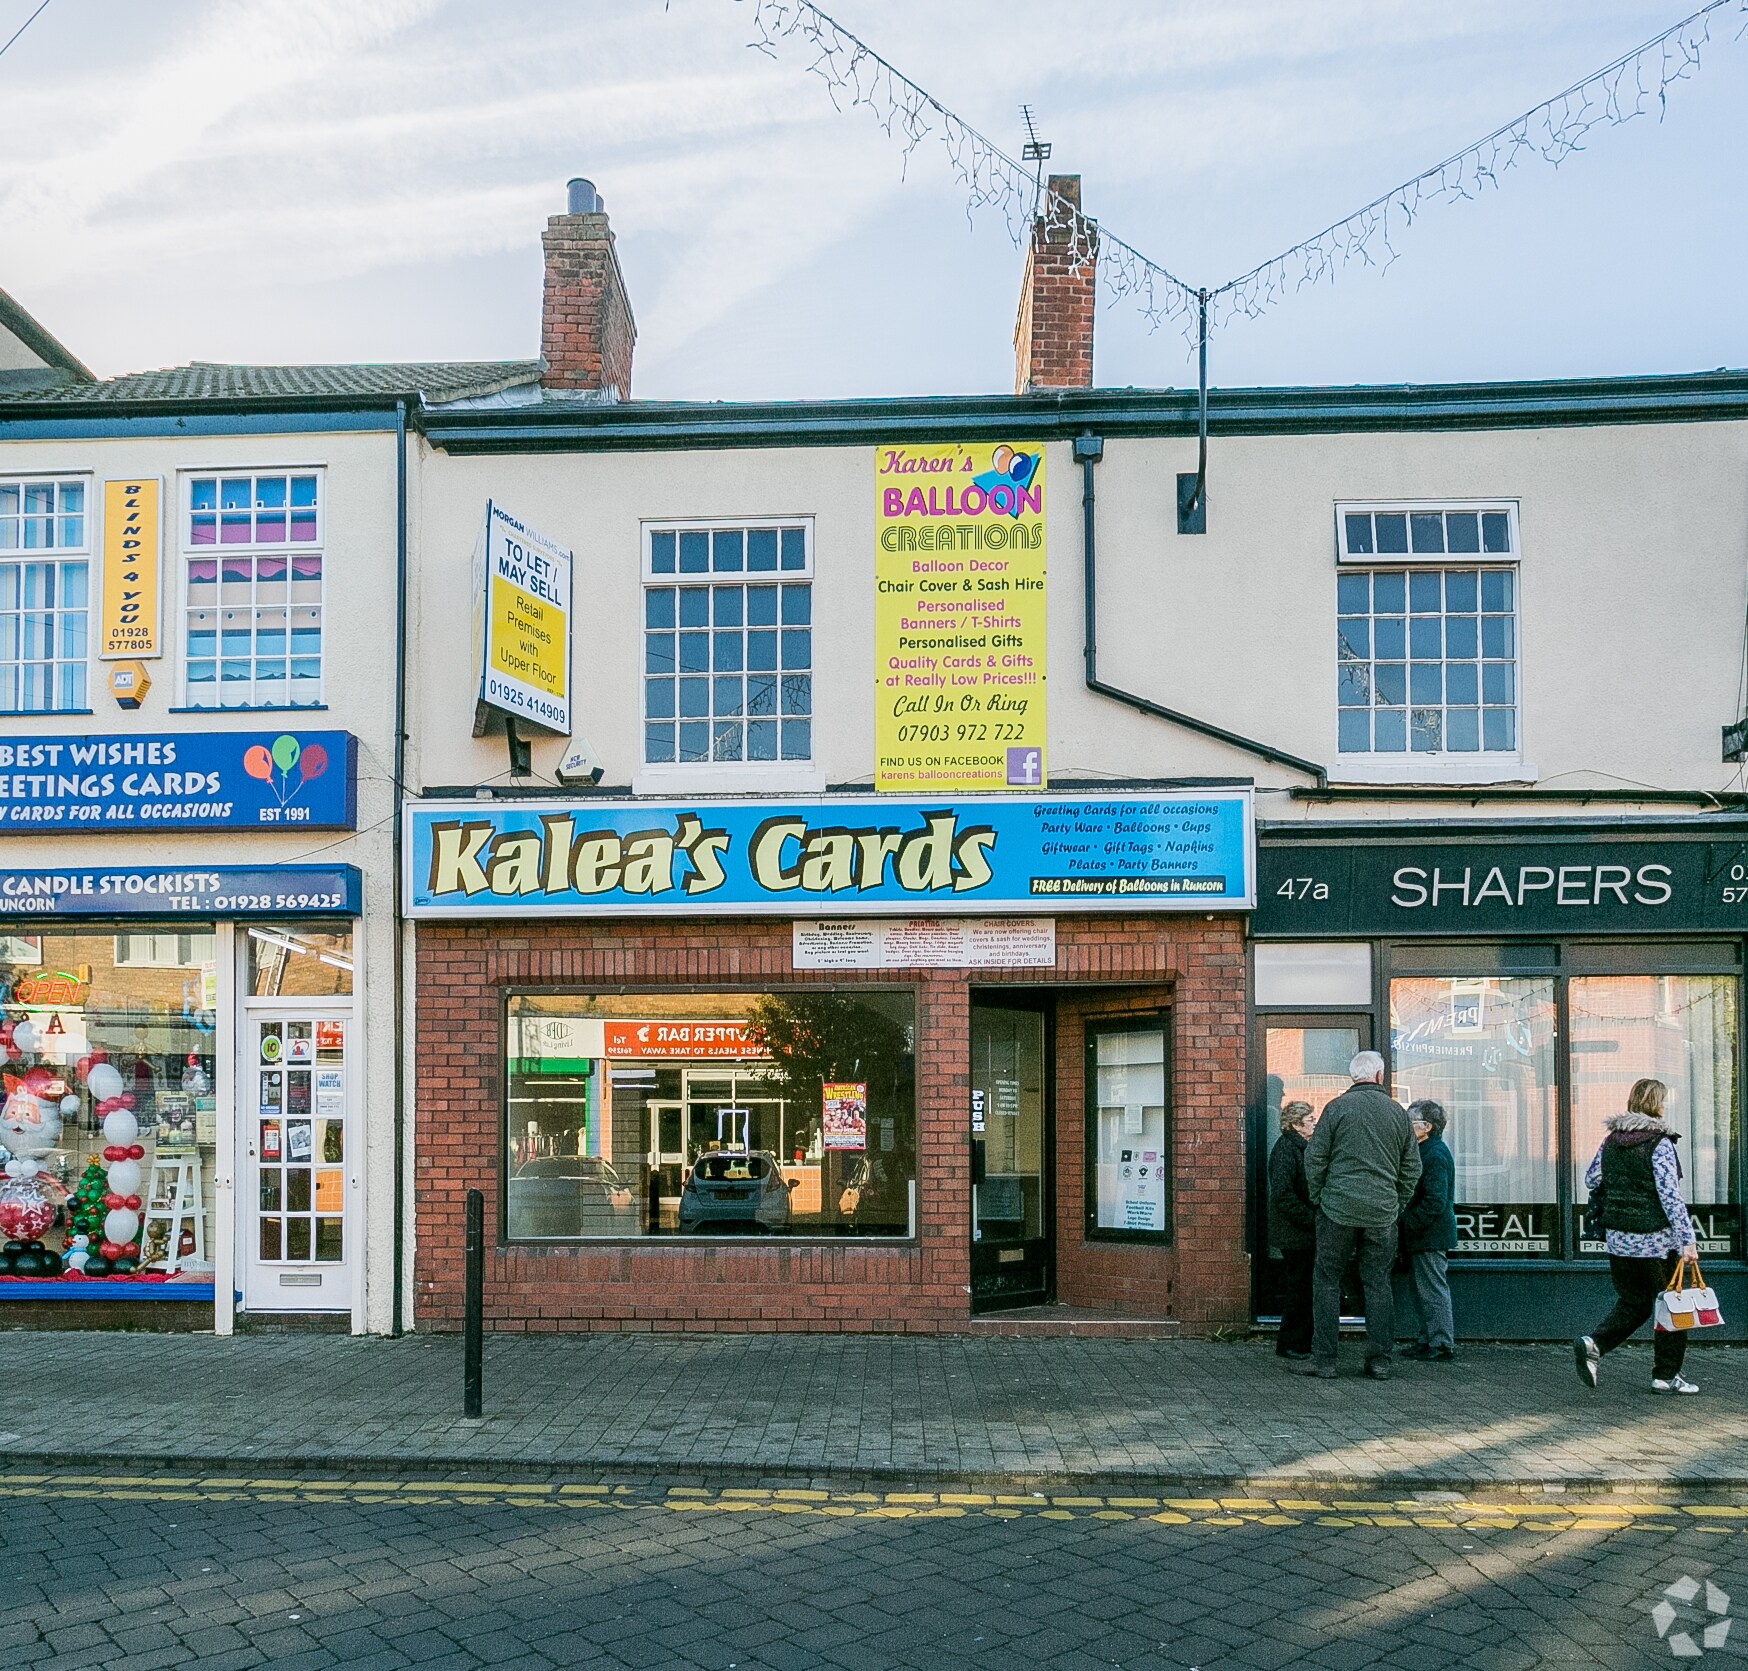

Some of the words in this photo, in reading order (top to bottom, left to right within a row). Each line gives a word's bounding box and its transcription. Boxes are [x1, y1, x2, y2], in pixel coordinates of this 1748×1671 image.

[880, 448, 973, 474] Karen's
[883, 484, 1042, 517] BALLOON
[493, 506, 524, 533] MORGAN
[880, 523, 1042, 552] CREATIONS
[505, 538, 522, 562] TO
[527, 552, 550, 579] LET
[912, 560, 964, 572] Balloon
[970, 560, 1009, 572] Decor
[499, 556, 526, 584] MAY
[530, 576, 562, 606] SELL
[878, 580, 914, 593] Chair
[920, 580, 957, 592] Cover
[963, 579, 972, 591] &
[978, 578, 1009, 592] Sash
[1016, 578, 1044, 590] Hire
[517, 596, 544, 622] Retail
[918, 600, 1004, 612] Personalised
[508, 611, 552, 644] Premises
[901, 617, 956, 630] Banners
[960, 616, 968, 629] /
[972, 616, 1022, 628] T-Shirts
[112, 628, 148, 638] 01928
[900, 636, 986, 648] Personalised
[992, 634, 1023, 647] Gifts
[108, 640, 152, 650] 577805
[520, 638, 538, 658] with
[500, 646, 530, 672] Upper
[532, 663, 556, 685] Floor
[889, 656, 937, 671] Quality
[943, 656, 981, 668] Cards
[986, 655, 996, 668] &
[1002, 654, 1033, 668] Gifts
[114, 674, 132, 685] ADT
[886, 675, 900, 686] at
[905, 674, 946, 688] Really
[952, 674, 977, 685] Low
[983, 672, 1036, 685] Prices!!!
[490, 680, 524, 707] 01925
[527, 696, 565, 724] 414909
[894, 694, 930, 717] Call
[934, 694, 954, 713] In
[960, 694, 980, 712] Or
[987, 694, 1028, 716] Ring
[898, 724, 950, 742] 07903
[956, 724, 987, 741] 972
[994, 724, 1025, 740] 722
[0, 744, 63, 767] BEST
[69, 742, 176, 766] WISHES
[881, 757, 905, 767] FIND
[908, 757, 922, 766] US
[925, 757, 941, 766] ON
[944, 756, 1004, 766] FACEBOOK
[566, 758, 587, 770] SECURITY
[881, 770, 915, 780] karens
[918, 770, 1003, 779] ballooncreations
[122, 771, 220, 797] CARDS
[10, 806, 65, 821] CARDS
[69, 806, 100, 821] FOR
[106, 804, 134, 819] ALL
[140, 802, 233, 818] OCCASIONS
[259, 808, 281, 821] EST
[284, 807, 310, 821] 1991
[1034, 804, 1080, 818] Greeting
[1084, 804, 1117, 816] Cards
[1120, 804, 1137, 817] for
[1140, 803, 1160, 815] all
[1163, 803, 1218, 815] occasions
[1041, 822, 1071, 835] Party
[1074, 822, 1103, 833] Ware
[1114, 822, 1170, 833] Balloons
[1182, 821, 1211, 833] Cups
[428, 812, 732, 896] Kalea's
[749, 809, 999, 894] Cards
[1041, 842, 1091, 855] Giftwear
[1104, 841, 1126, 855] Gift
[1128, 841, 1154, 855] Tags
[1165, 840, 1214, 854] Napkins
[1069, 859, 1107, 870] Plates
[1118, 859, 1148, 872] Party
[1151, 859, 1198, 870] Banners
[1731, 864, 1748, 880] 0
[2, 876, 93, 896] CANDLE
[99, 873, 220, 894] STOCKISTS
[1032, 880, 1061, 892] FREE
[1062, 879, 1103, 895] Delivery
[1106, 879, 1117, 894] of
[1119, 879, 1169, 892] Balloons
[1170, 879, 1180, 892] in
[1182, 879, 1223, 891] Runcorn
[1276, 878, 1328, 901] 47a
[1390, 864, 1673, 908] SHAPERS
[0, 897, 55, 912] UNCORN
[214, 895, 271, 910] 01928
[275, 894, 341, 909] 569425
[17, 981, 81, 1004] OPEN
[972, 1090, 985, 1131] PUSH
